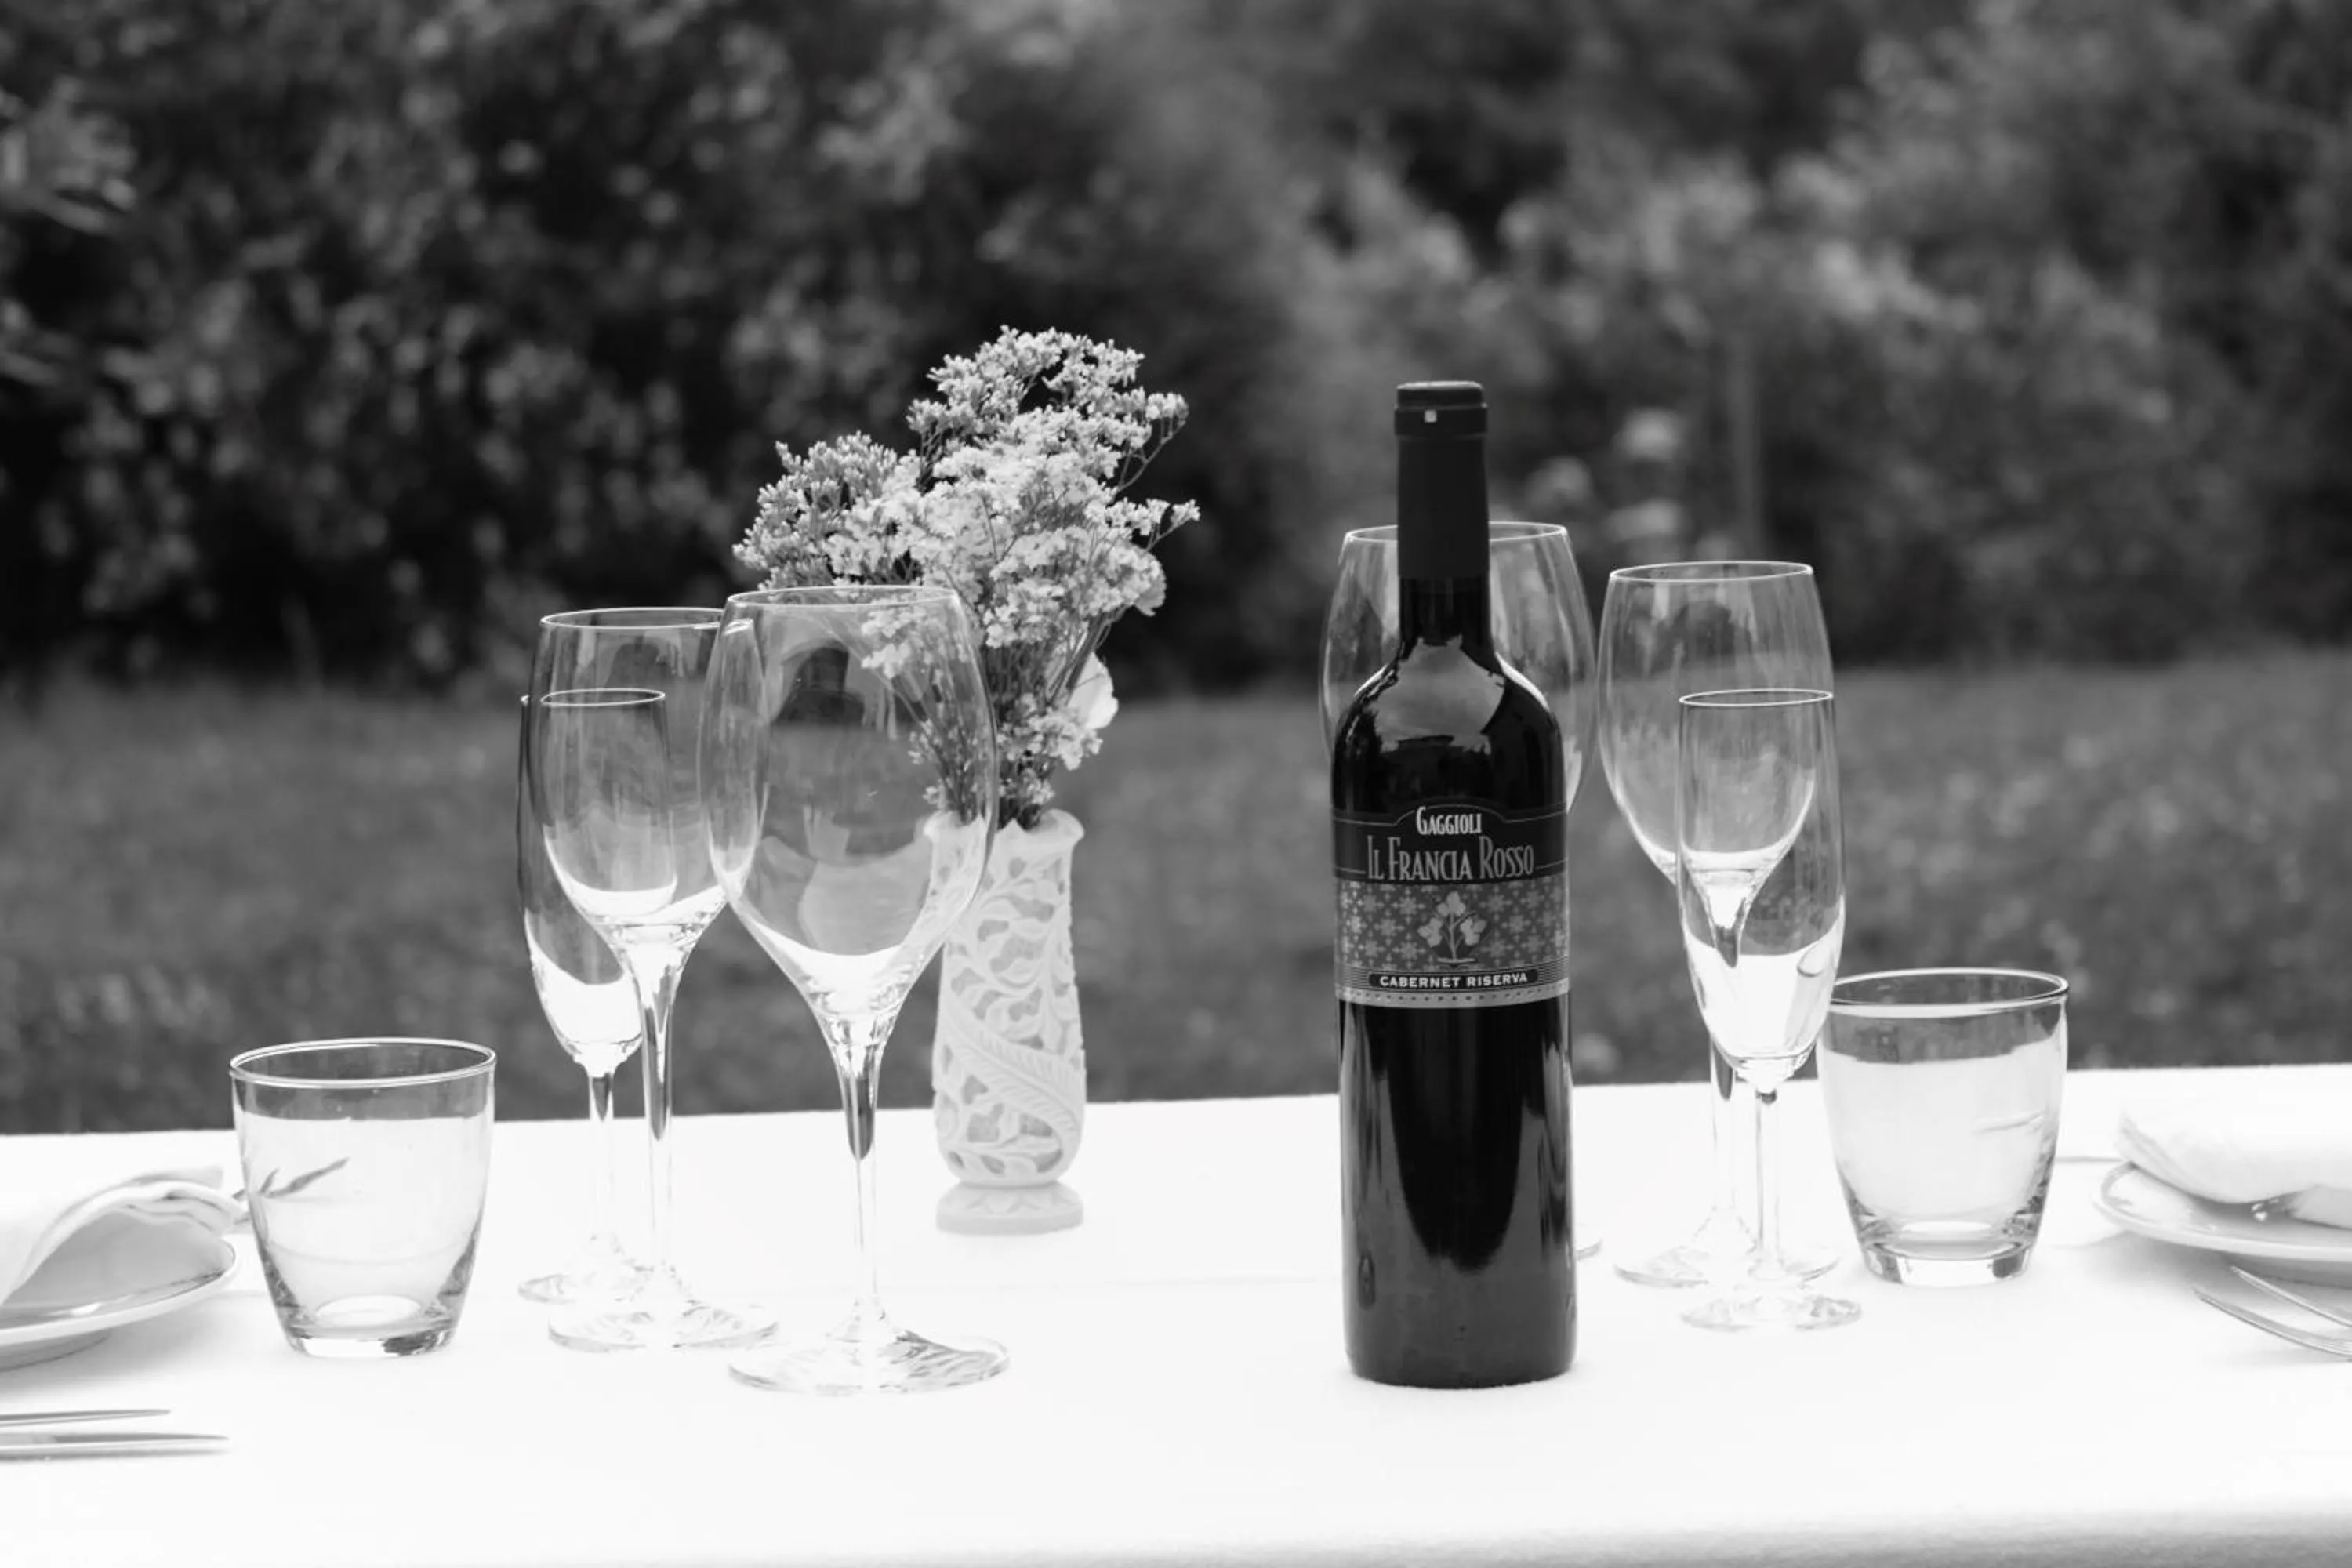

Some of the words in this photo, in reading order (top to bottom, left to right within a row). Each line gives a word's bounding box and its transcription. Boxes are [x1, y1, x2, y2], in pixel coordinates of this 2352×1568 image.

[1417, 806, 1482, 835] GAGGIOLI
[1367, 835, 1384, 880] IL
[1387, 837, 1473, 880] FRANCIA
[1479, 835, 1534, 879] ROSSO
[1379, 975, 1462, 988] CABERNET
[1467, 972, 1528, 987] RISERVA
